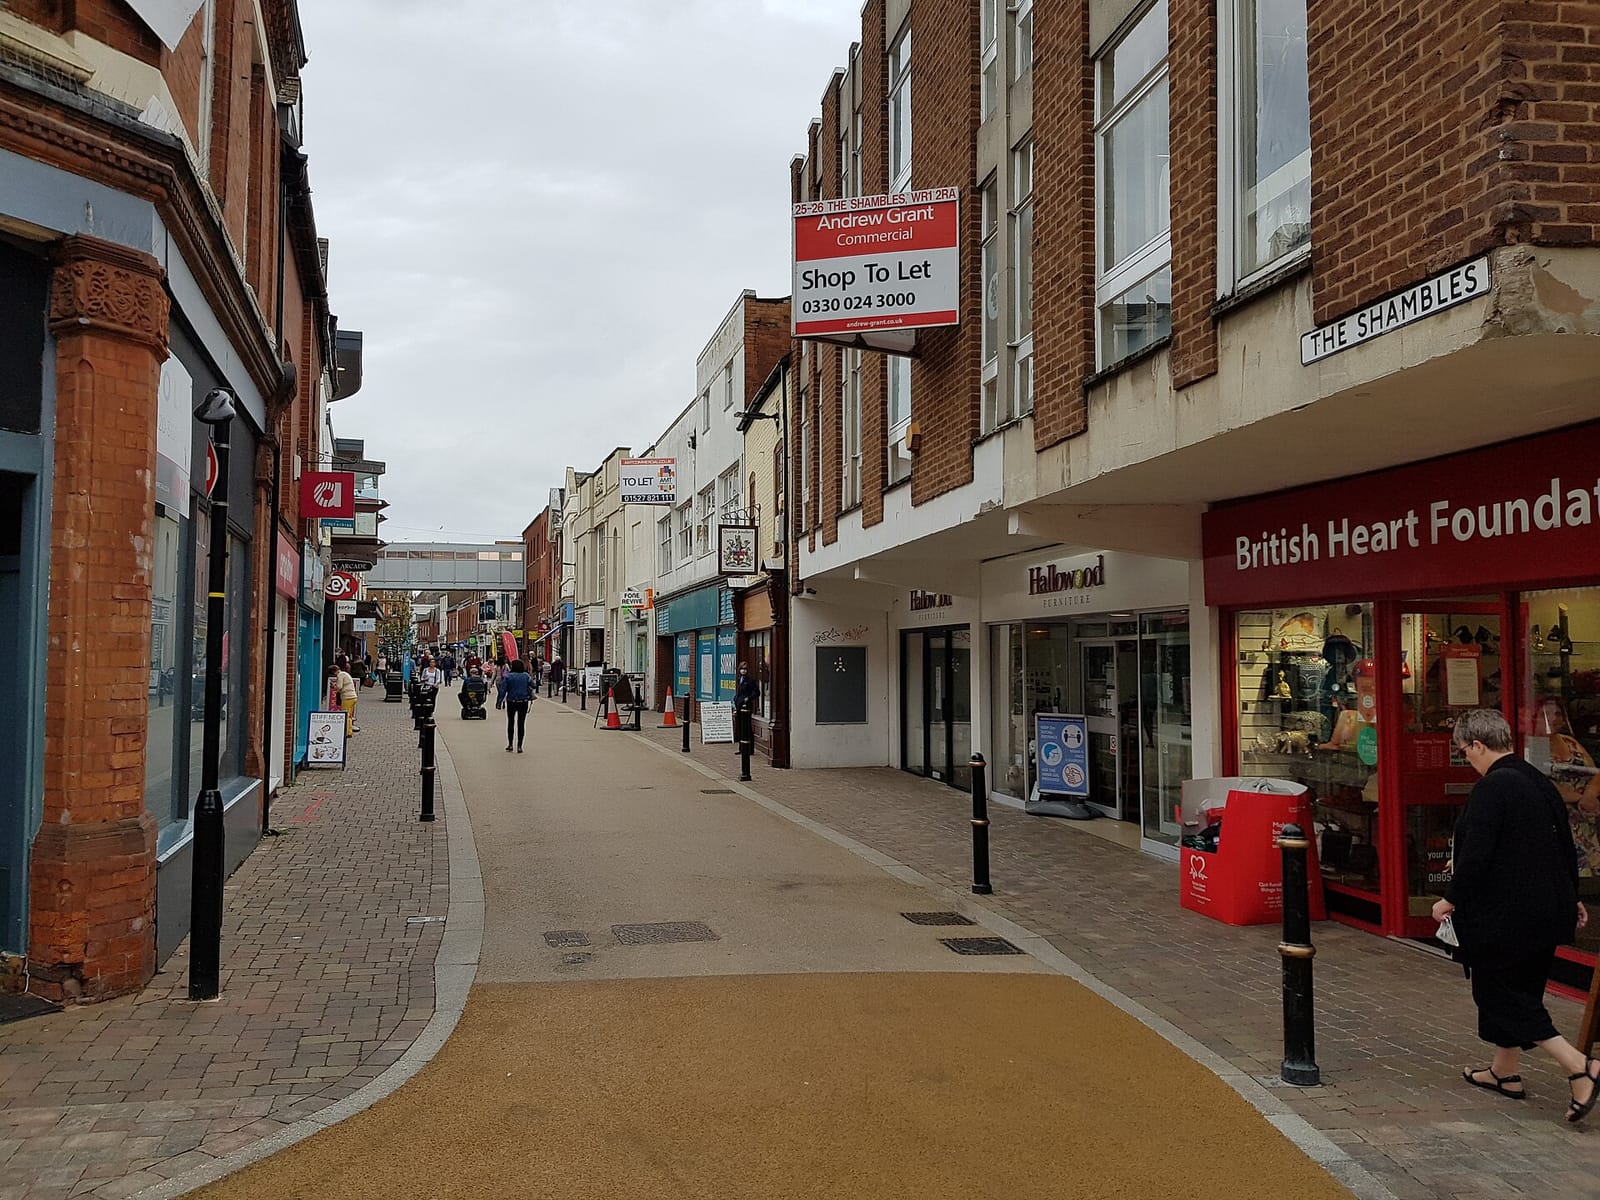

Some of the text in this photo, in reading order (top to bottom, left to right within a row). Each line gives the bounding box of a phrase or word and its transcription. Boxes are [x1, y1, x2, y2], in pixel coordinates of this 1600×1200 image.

[795, 202, 824, 215] 25-26
[828, 200, 846, 212] THE
[911, 189, 933, 202] WR1
[935, 188, 956, 200] 2RA
[816, 205, 934, 231] Andrew Grant
[836, 227, 913, 246] Commercial
[802, 260, 932, 291] Shop To Let
[802, 292, 916, 313] 0330 024 3000
[1310, 264, 1478, 356] THE SHAMBLES
[846, 318, 903, 328] andrew-grant.co.uk
[622, 477, 654, 487] TO LET
[1235, 522, 1320, 570] British
[1327, 509, 1420, 558] Heart
[1028, 555, 1105, 595] Hallowood
[1043, 594, 1091, 608] FURNITURE
[1427, 851, 1444, 860] your
[1428, 873, 1452, 882] 01905
